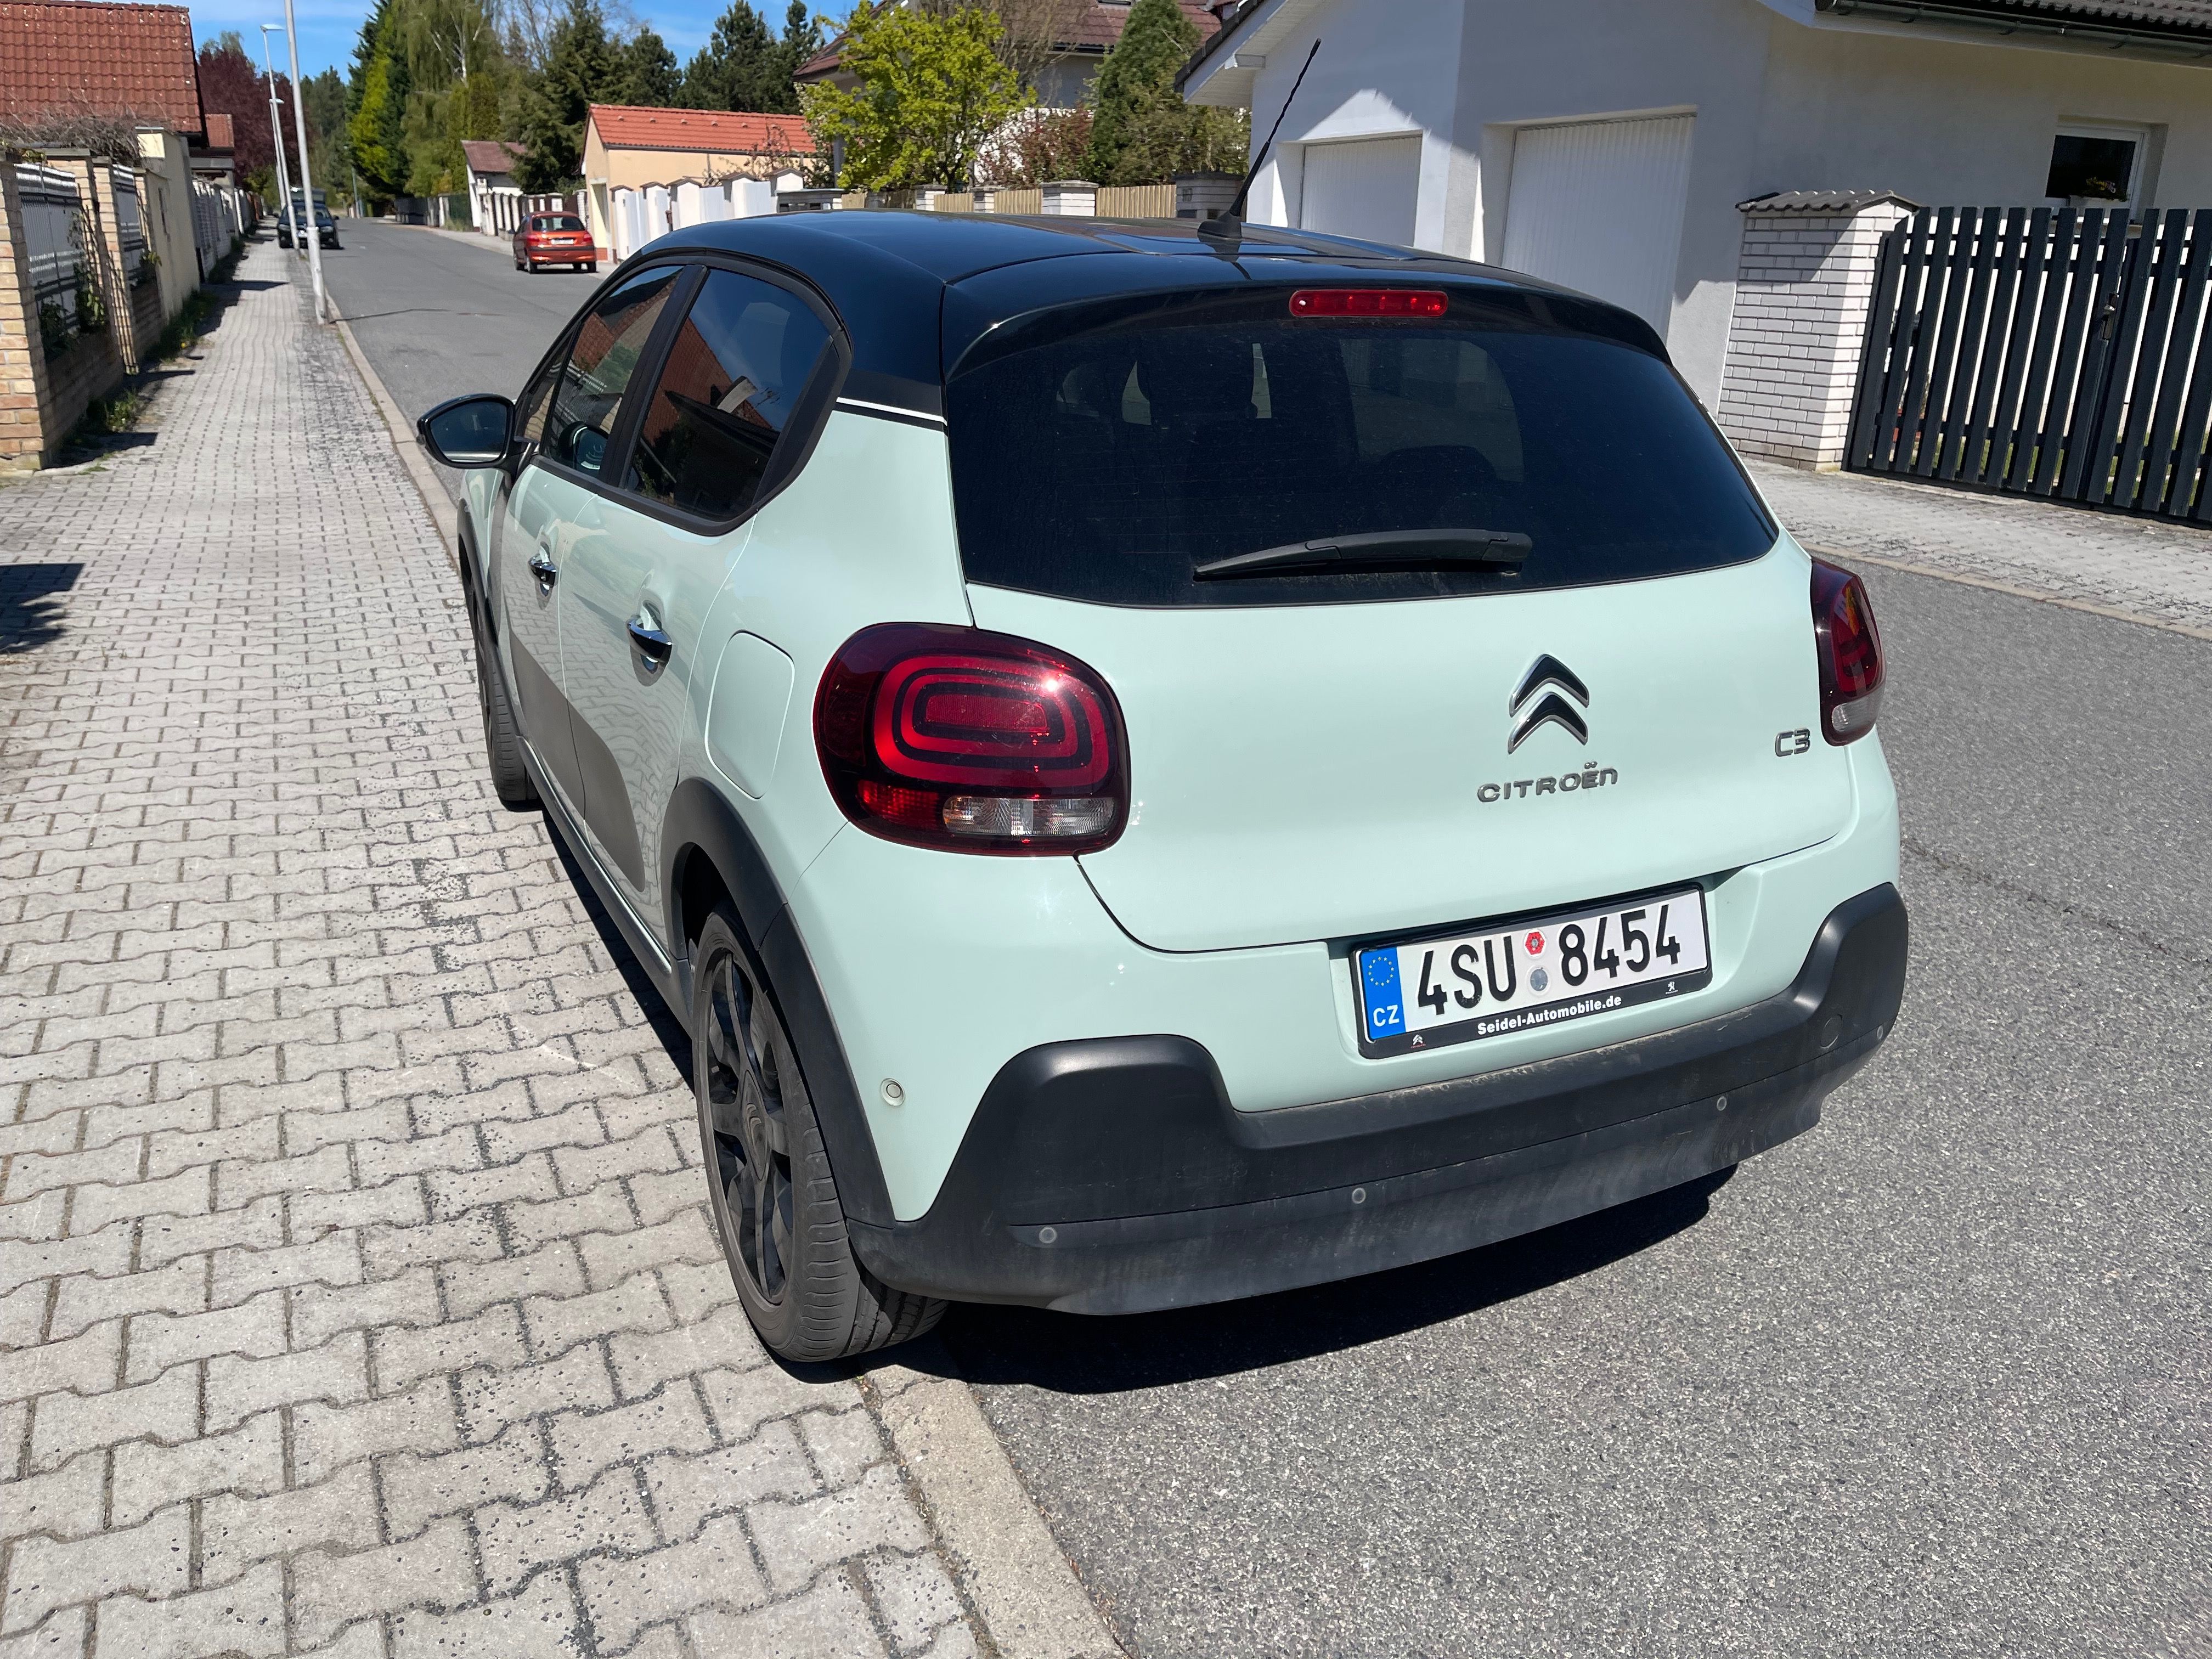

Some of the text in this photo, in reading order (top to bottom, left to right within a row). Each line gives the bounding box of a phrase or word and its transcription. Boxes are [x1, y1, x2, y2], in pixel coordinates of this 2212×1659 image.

[1775, 728, 1811, 757] C3
[1418, 904, 1680, 1015] 4SU 8454
[1373, 1005, 1400, 1027] CZ
[1477, 995, 1622, 1035] Seidel-Automobile.de
